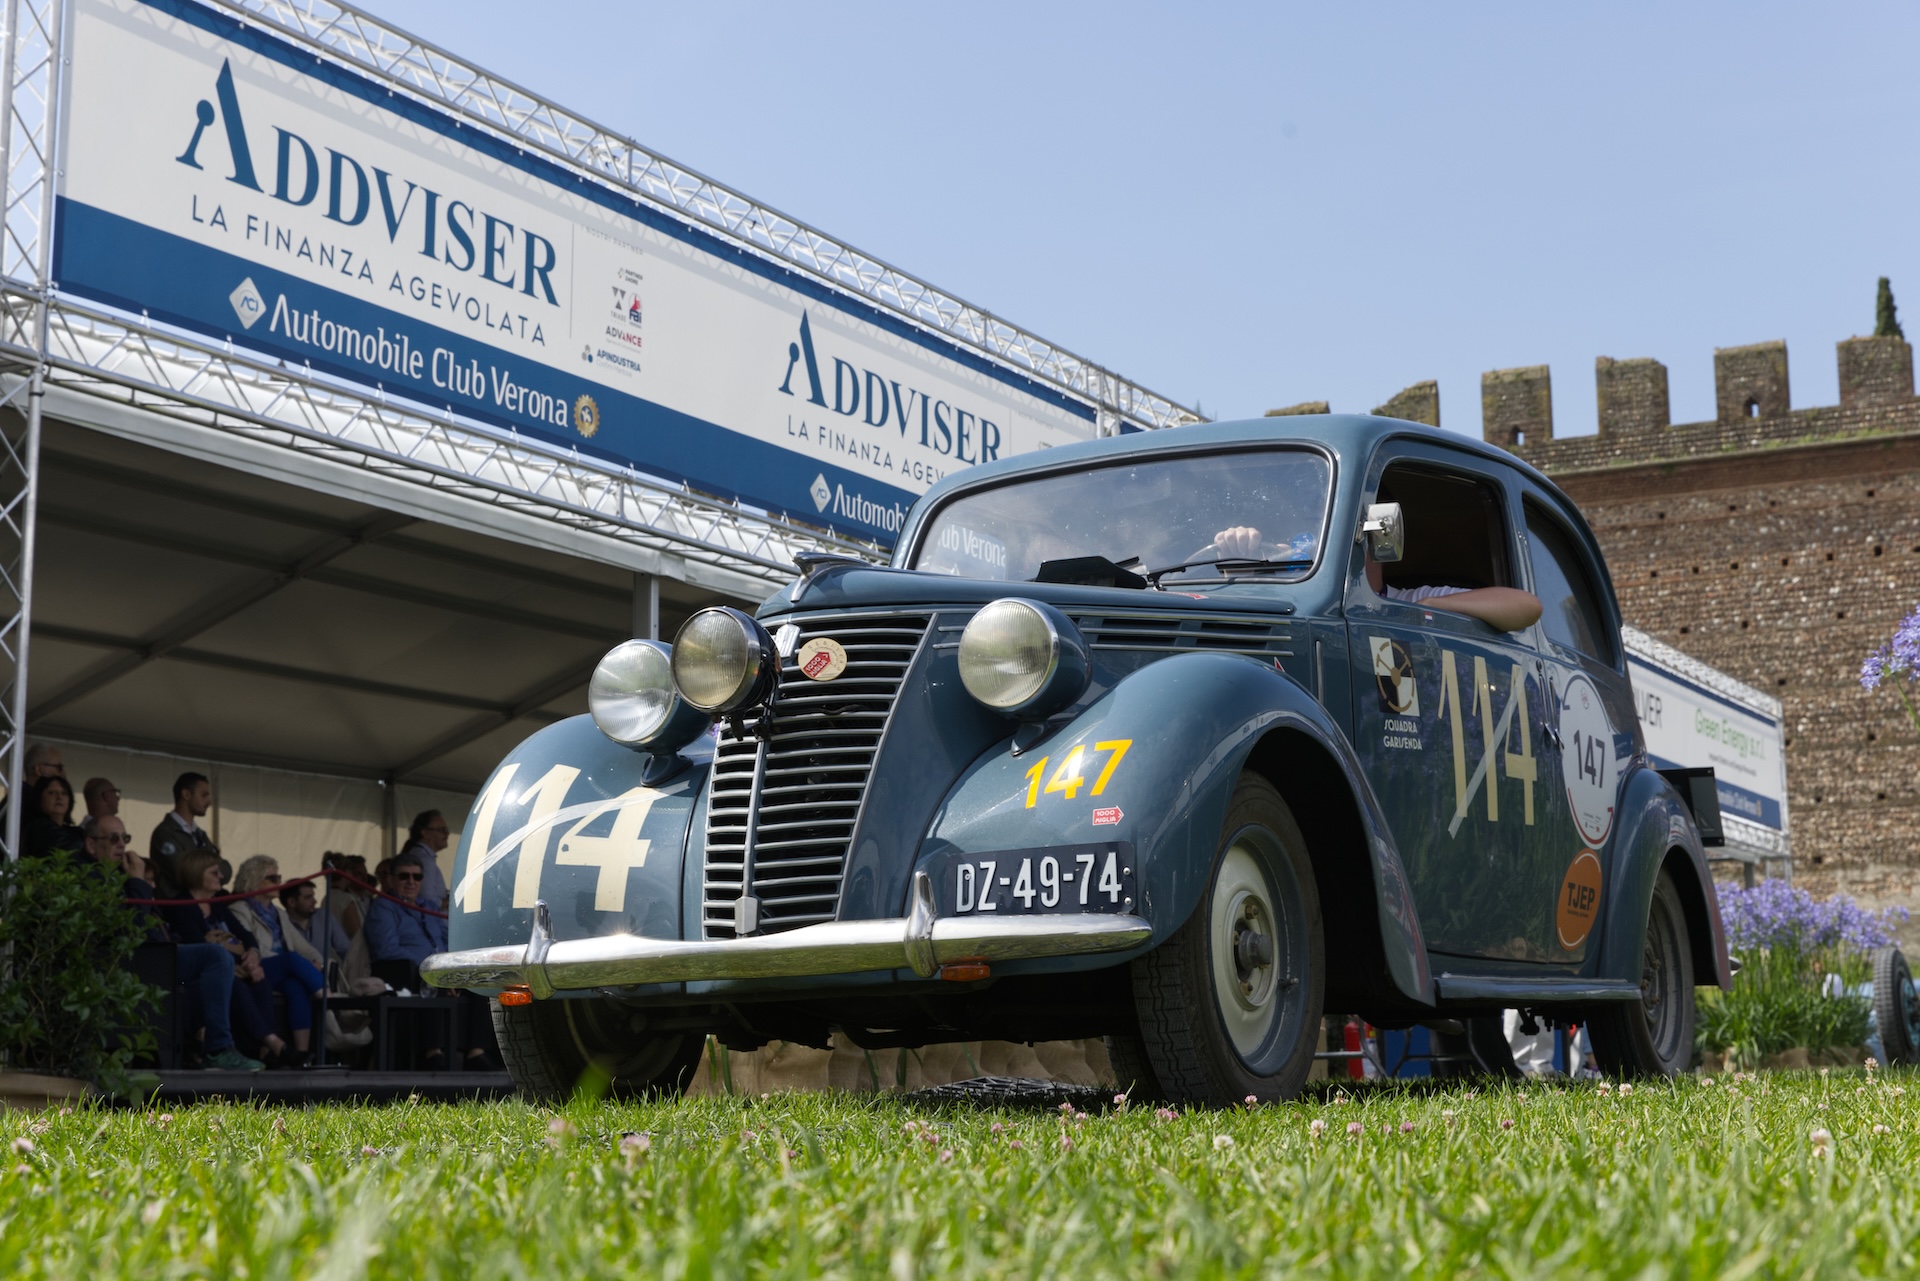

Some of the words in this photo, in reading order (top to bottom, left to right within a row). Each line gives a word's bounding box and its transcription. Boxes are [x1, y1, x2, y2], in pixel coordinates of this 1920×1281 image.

[176, 57, 560, 307] ADDVISER
[193, 195, 227, 232] LA
[247, 214, 373, 284] FINANZA
[389, 270, 545, 346] AGEVOLATA
[240, 296, 258, 312] ACI
[270, 294, 423, 380] Automobile
[432, 347, 486, 400] Club
[491, 366, 569, 427] Verona
[596, 349, 641, 371] APINDUSTRIA
[606, 325, 642, 347] ADVANCE
[778, 308, 1001, 466] ADDVISER
[788, 415, 809, 440] LA
[819, 426, 893, 471] FINANZA
[833, 483, 909, 533] Automob
[805, 656, 821, 671] 1000
[810, 659, 828, 677] MIGLIA
[1383, 735, 1422, 750] GARISENDA
[1384, 719, 1418, 733] SQUADRA
[1437, 650, 1537, 825] 114
[1695, 708, 1720, 741] Green
[1722, 719, 1748, 758] Energy
[1025, 739, 1133, 809] 147
[1574, 730, 1605, 788] 147
[463, 763, 652, 914] 114
[956, 852, 1122, 913] DZ-49-74
[1567, 882, 1595, 911] TJEP
